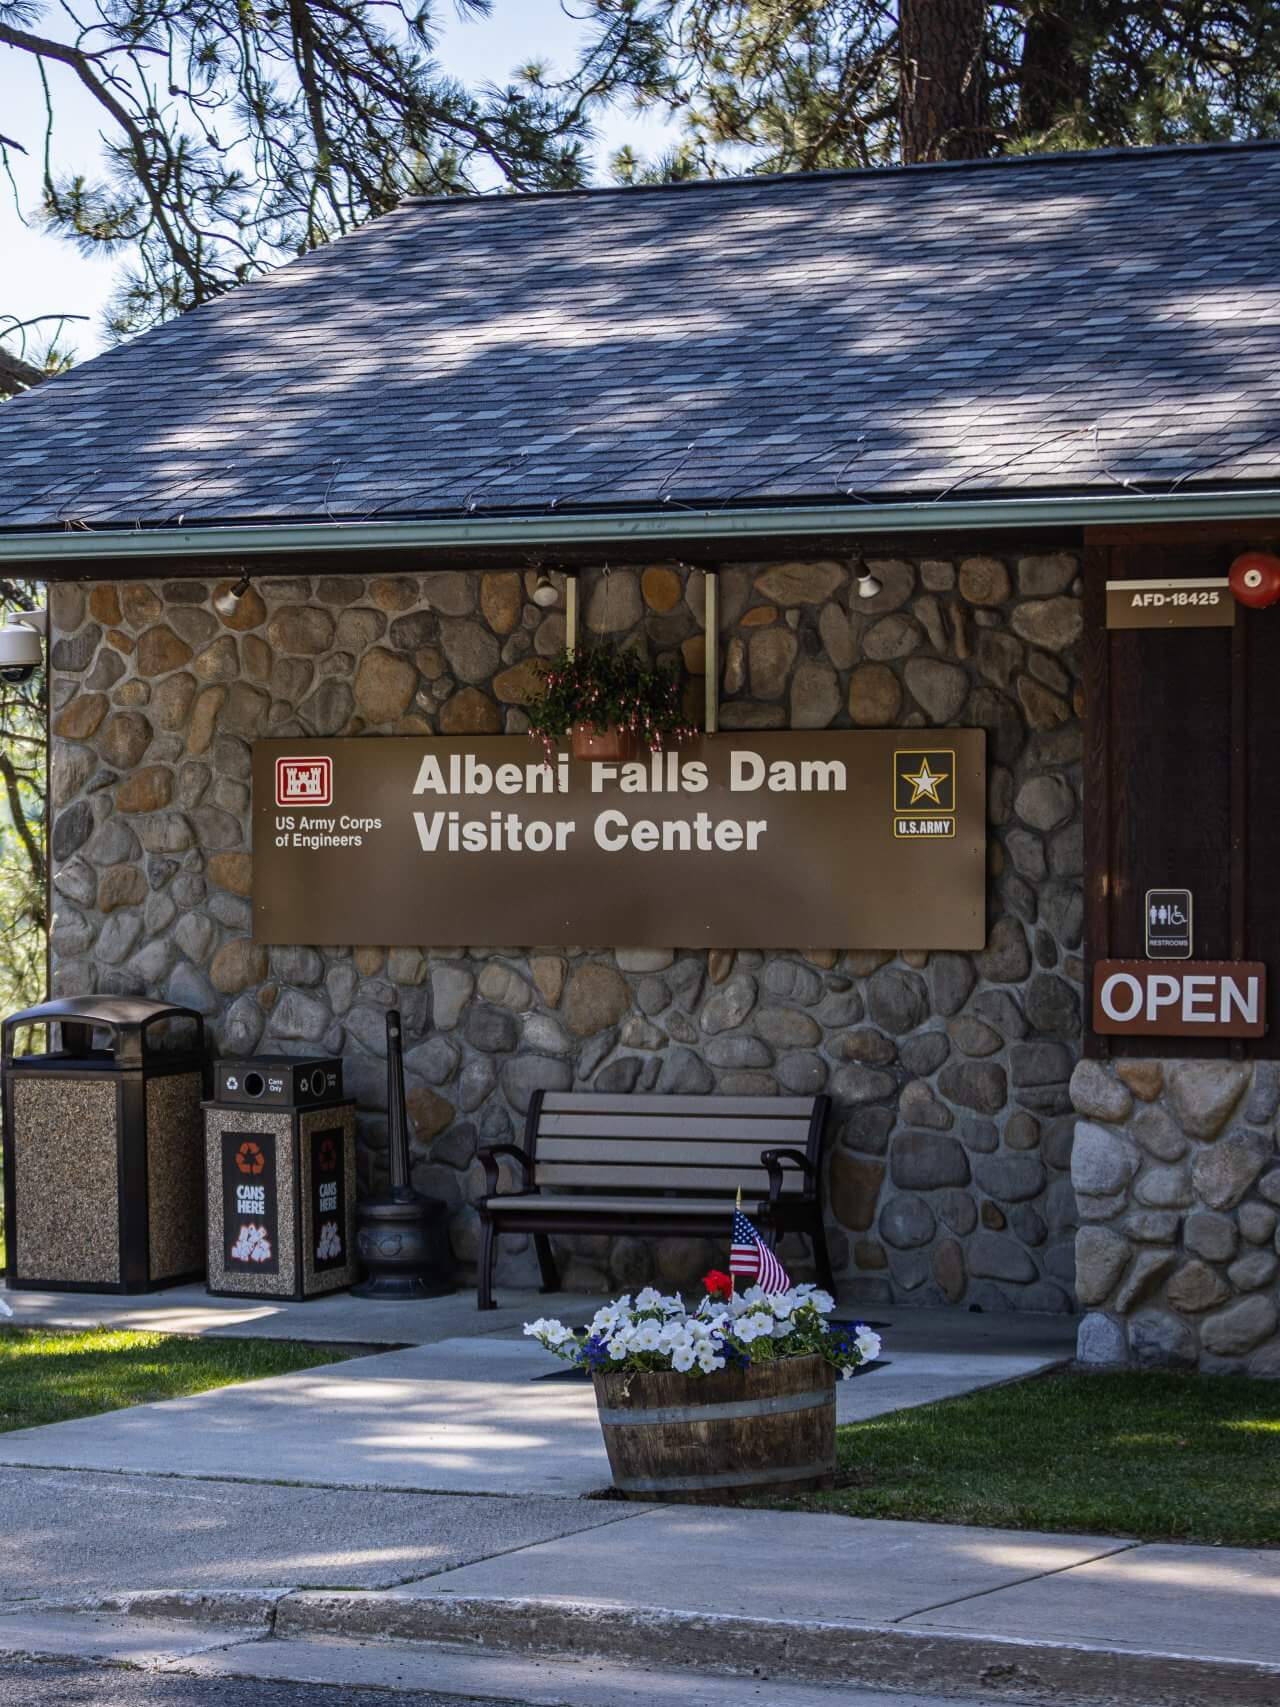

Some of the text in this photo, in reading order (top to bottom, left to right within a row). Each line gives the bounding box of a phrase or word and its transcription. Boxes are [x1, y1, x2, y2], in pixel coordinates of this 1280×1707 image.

[1131, 592, 1220, 607] AFD-18425
[412, 750, 847, 795] Albeni Falls Dam
[275, 815, 382, 833] US Army Corps
[413, 809, 768, 852] Visitor Center
[899, 821, 950, 834] U.S.ARMY
[275, 833, 362, 850] of Engineers
[1149, 939, 1188, 947] RESTROOMS
[1100, 973, 1259, 1024] OPEN
[269, 1085, 282, 1093] Only
[236, 1185, 265, 1200] CANS
[319, 1182, 337, 1198] CANS
[237, 1200, 265, 1215] HERE
[319, 1197, 337, 1212] HERE
